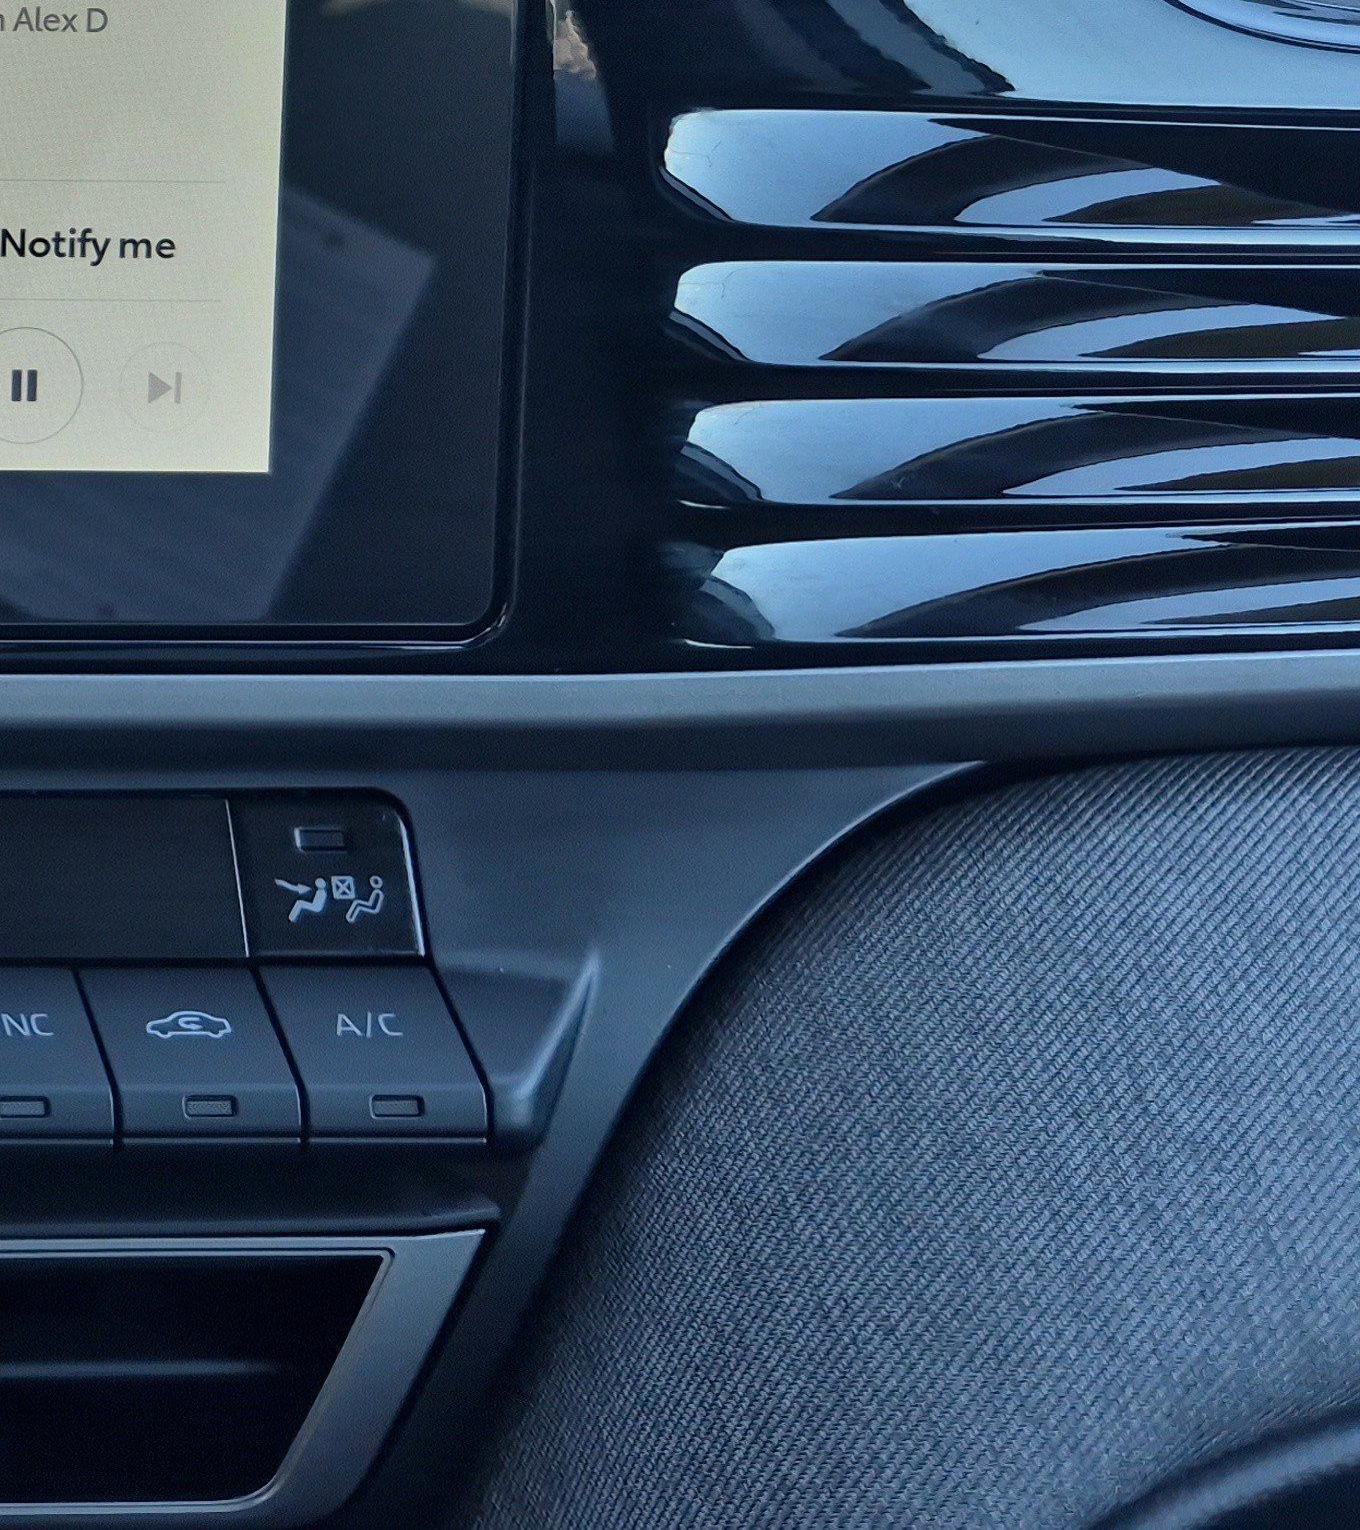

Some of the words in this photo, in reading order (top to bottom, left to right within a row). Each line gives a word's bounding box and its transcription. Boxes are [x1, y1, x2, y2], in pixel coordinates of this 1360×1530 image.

[12, 7, 79, 32] Alex
[86, 8, 109, 33] D
[0, 227, 111, 266] Notify
[118, 236, 176, 261] me
[335, 1012, 404, 1038] A/C
